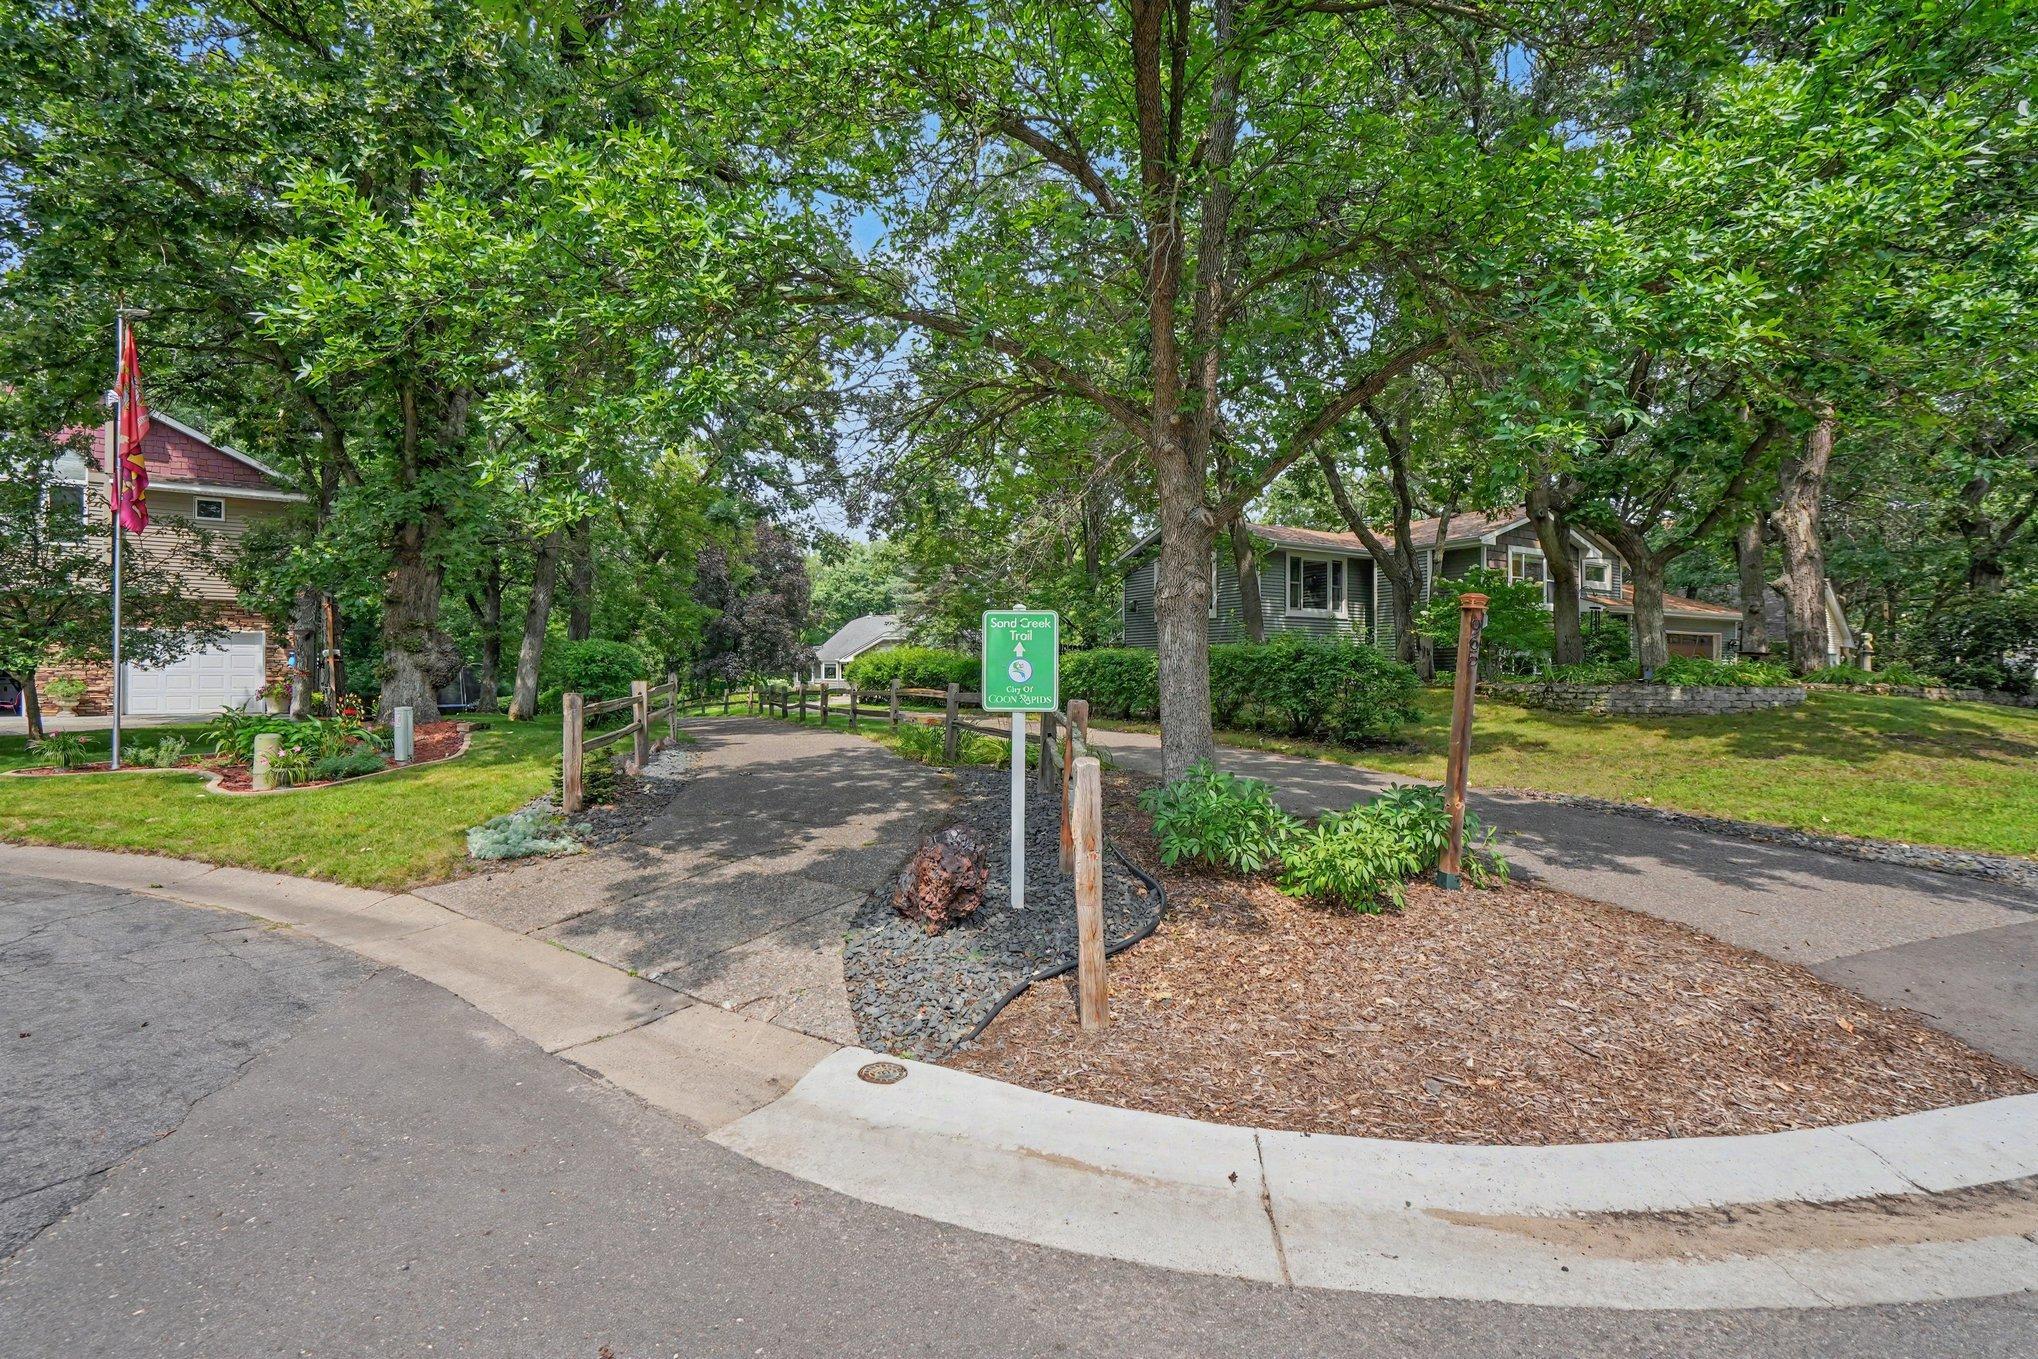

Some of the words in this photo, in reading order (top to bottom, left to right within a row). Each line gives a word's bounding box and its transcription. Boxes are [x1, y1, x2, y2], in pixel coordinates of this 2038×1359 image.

[990, 617, 1017, 628] Sand
[1020, 617, 1051, 628] Creek
[1009, 629, 1033, 641] Trail
